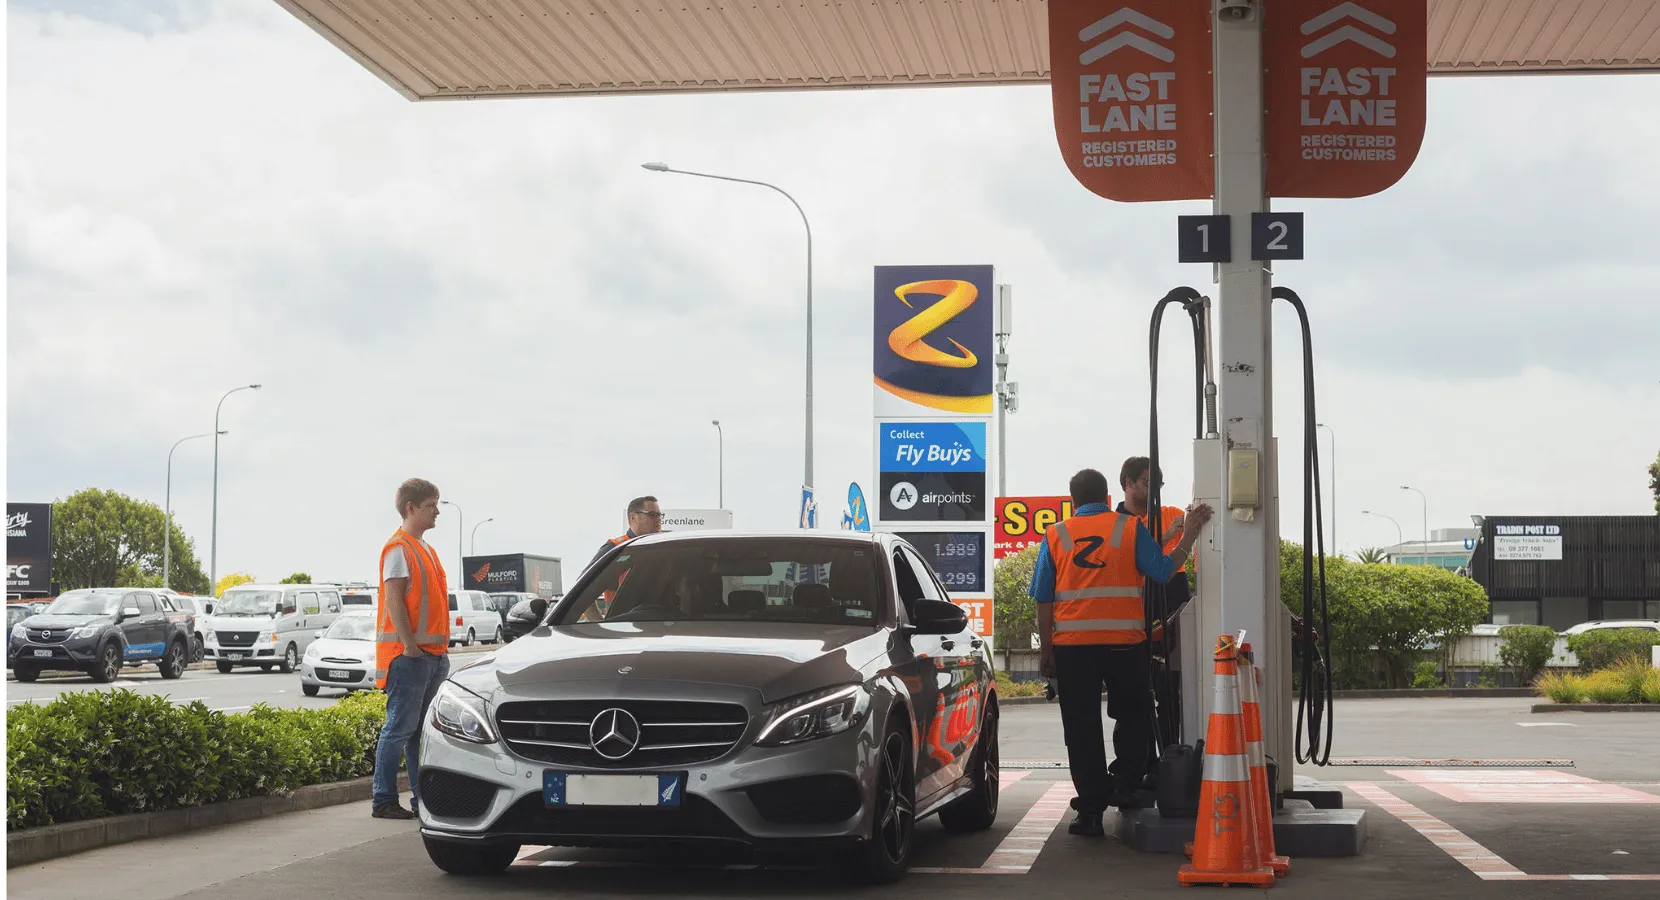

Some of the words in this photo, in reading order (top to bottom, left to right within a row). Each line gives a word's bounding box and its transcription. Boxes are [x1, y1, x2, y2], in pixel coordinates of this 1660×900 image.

[1079, 72, 1175, 102] FAST
[1301, 67, 1396, 96] FAST
[1080, 103, 1176, 133] LANE
[1301, 99, 1396, 126] LANE
[1081, 139, 1177, 153] REGISTERED
[1301, 134, 1396, 147] REGISTERED
[1083, 153, 1177, 167] CUSTOMERS
[1302, 148, 1396, 161] CUSTOMERS
[1196, 223, 1209, 253] 1
[1266, 220, 1288, 249] 2
[888, 279, 978, 368] Z
[890, 430, 924, 439] Collect
[896, 444, 924, 466] Fly
[927, 443, 971, 466] Buys
[922, 492, 972, 506] airpoints
[1496, 525, 1524, 535] TRADIN
[1525, 525, 1545, 535] POST
[1546, 525, 1560, 535] LTD
[934, 543, 977, 556] 1.989
[1015, 541, 1024, 549] &
[1073, 535, 1106, 569] Z
[487, 570, 517, 578] MULFORD
